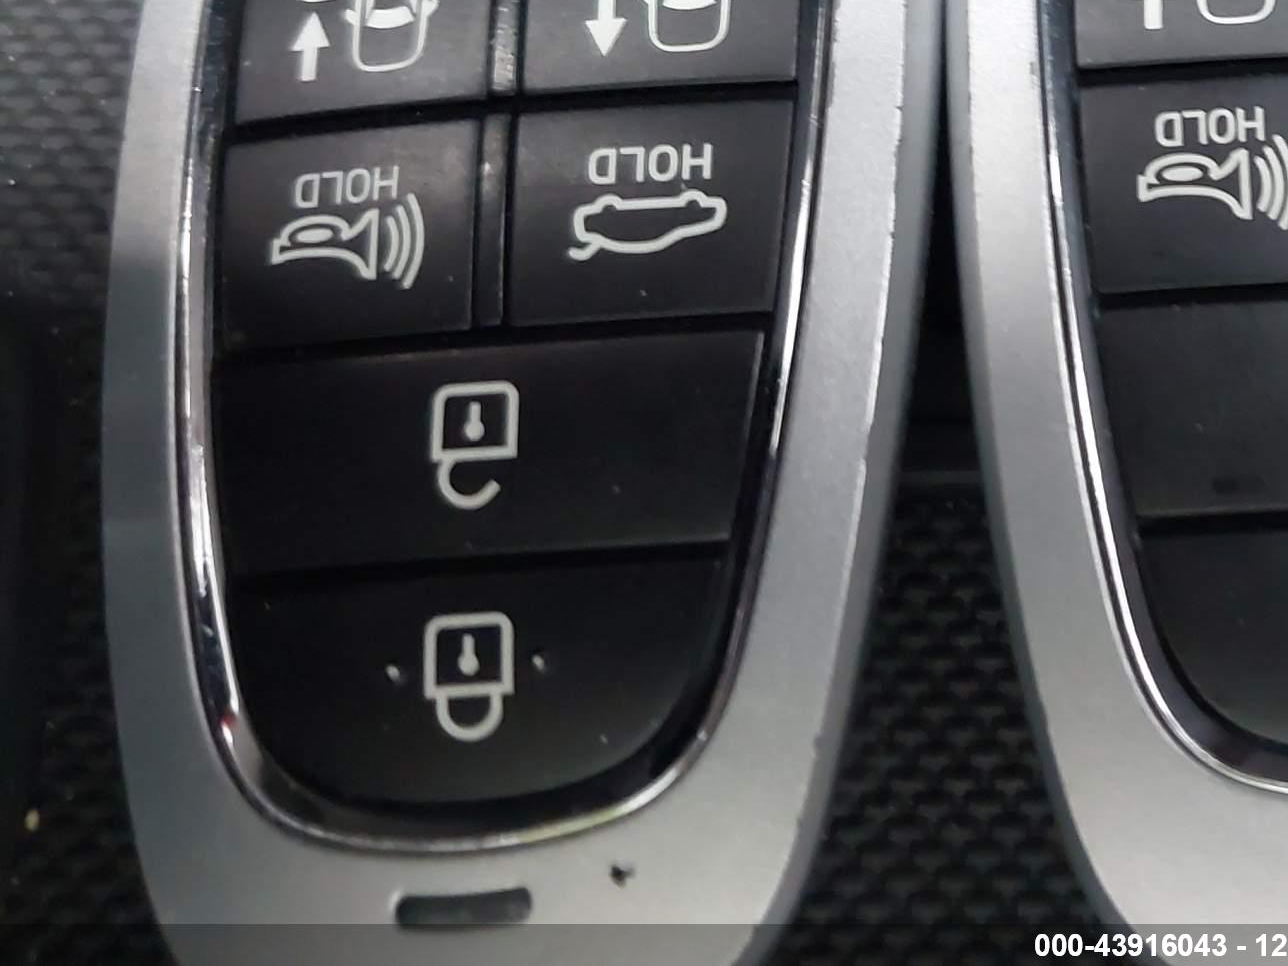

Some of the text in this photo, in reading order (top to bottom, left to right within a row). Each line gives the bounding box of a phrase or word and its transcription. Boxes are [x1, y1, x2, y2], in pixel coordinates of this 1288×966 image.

[1155, 107, 1266, 145] HOLD
[588, 144, 712, 186] HOLD
[293, 165, 399, 208] HOLD
